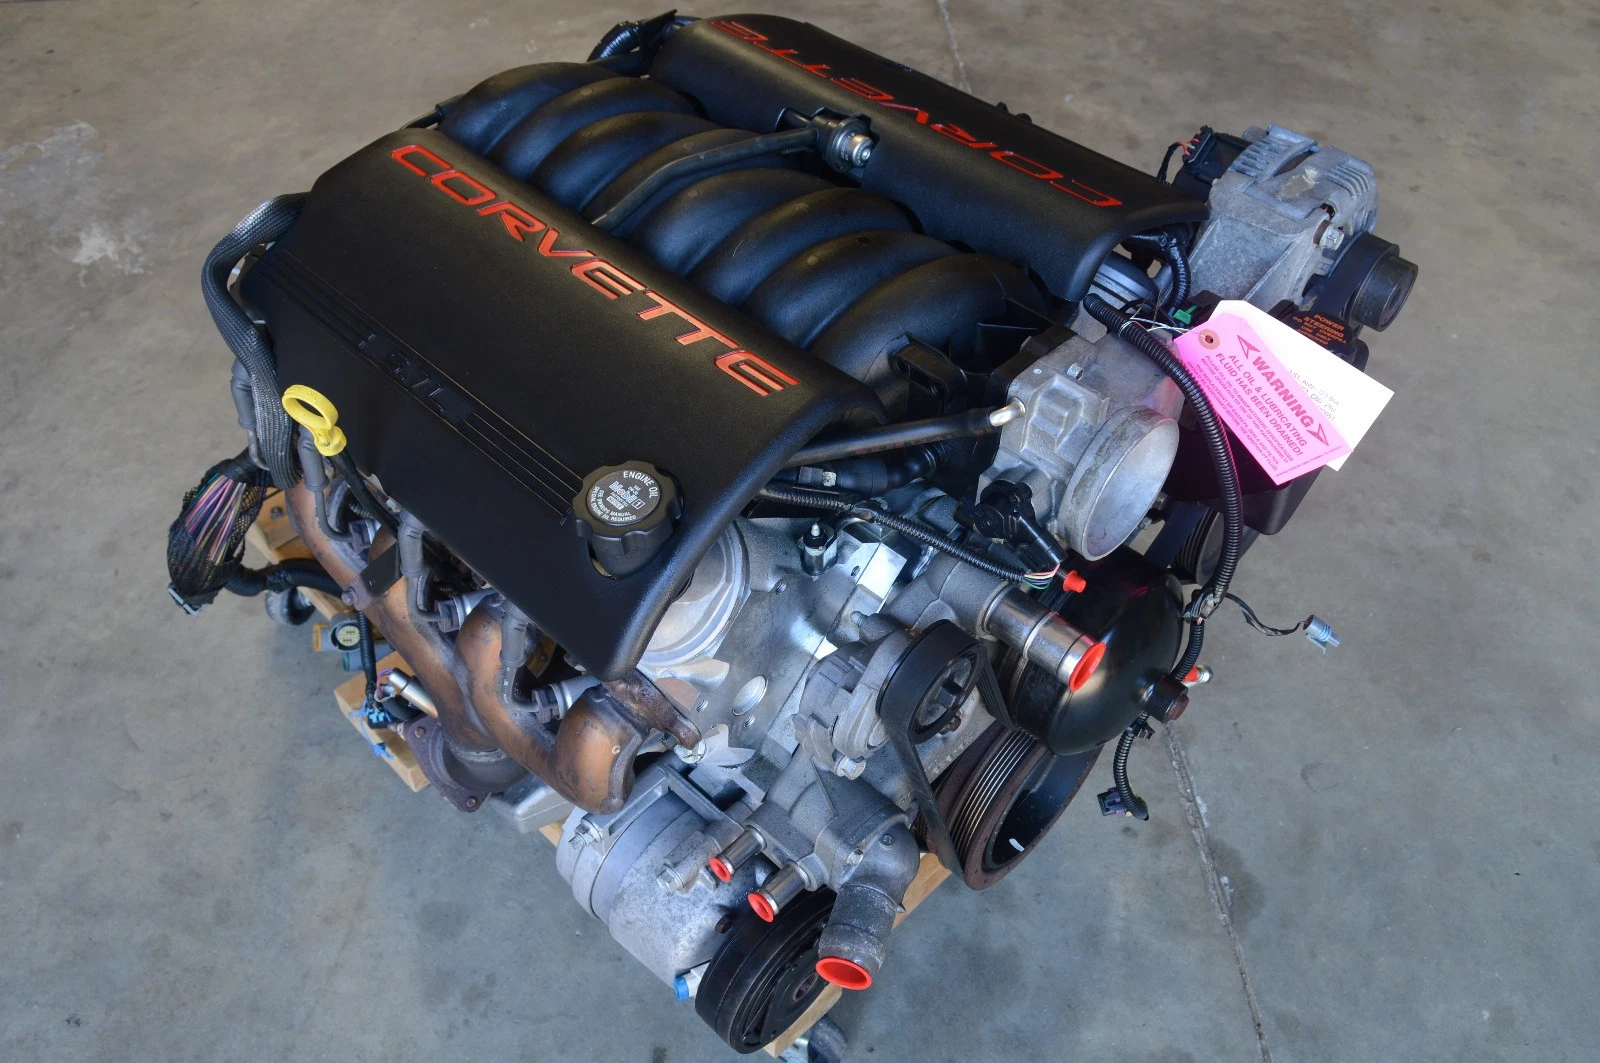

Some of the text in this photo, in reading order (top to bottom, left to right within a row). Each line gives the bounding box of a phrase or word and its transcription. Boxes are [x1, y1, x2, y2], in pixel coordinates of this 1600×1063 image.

[710, 21, 1122, 206] CORVETTE
[391, 144, 800, 397] CORVETTE
[1303, 316, 1345, 338] STEERING
[1314, 314, 1344, 330] POWER
[1215, 353, 1303, 456] FLUID HAS BEEN DRAINED!
[1228, 354, 1244, 370] ALL
[1242, 371, 1256, 384] OIL
[1260, 393, 1307, 446] LUBRICATING
[1251, 356, 1315, 428] WARNING
[608, 480, 638, 504] Mobil
[623, 470, 658, 498] ENGINE OIL
